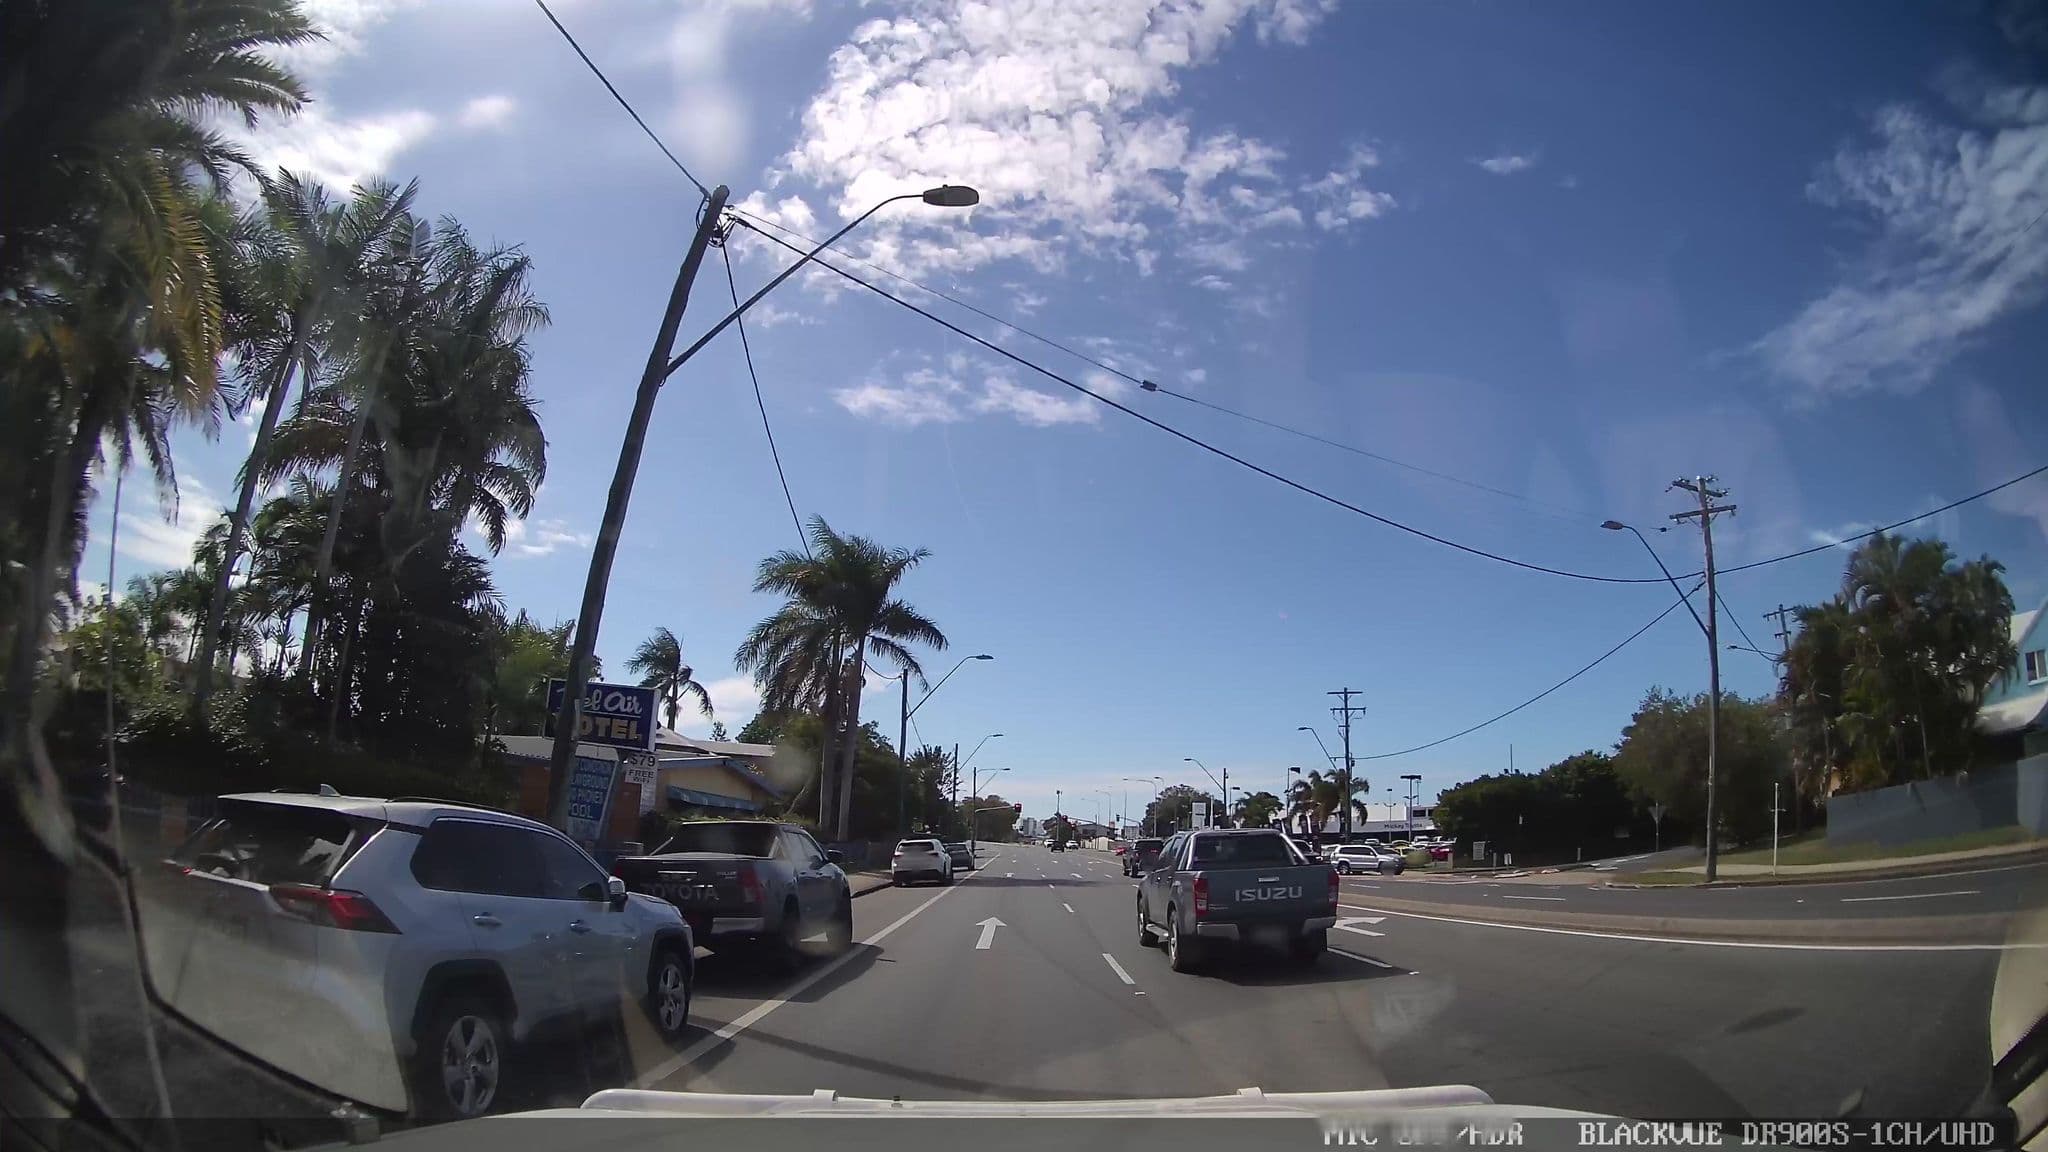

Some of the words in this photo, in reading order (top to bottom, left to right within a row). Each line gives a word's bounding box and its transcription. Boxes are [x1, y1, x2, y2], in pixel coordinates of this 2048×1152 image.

[603, 691, 642, 714] Air
[628, 769, 655, 779] FREE
[1234, 886, 1302, 901] ISUZU
